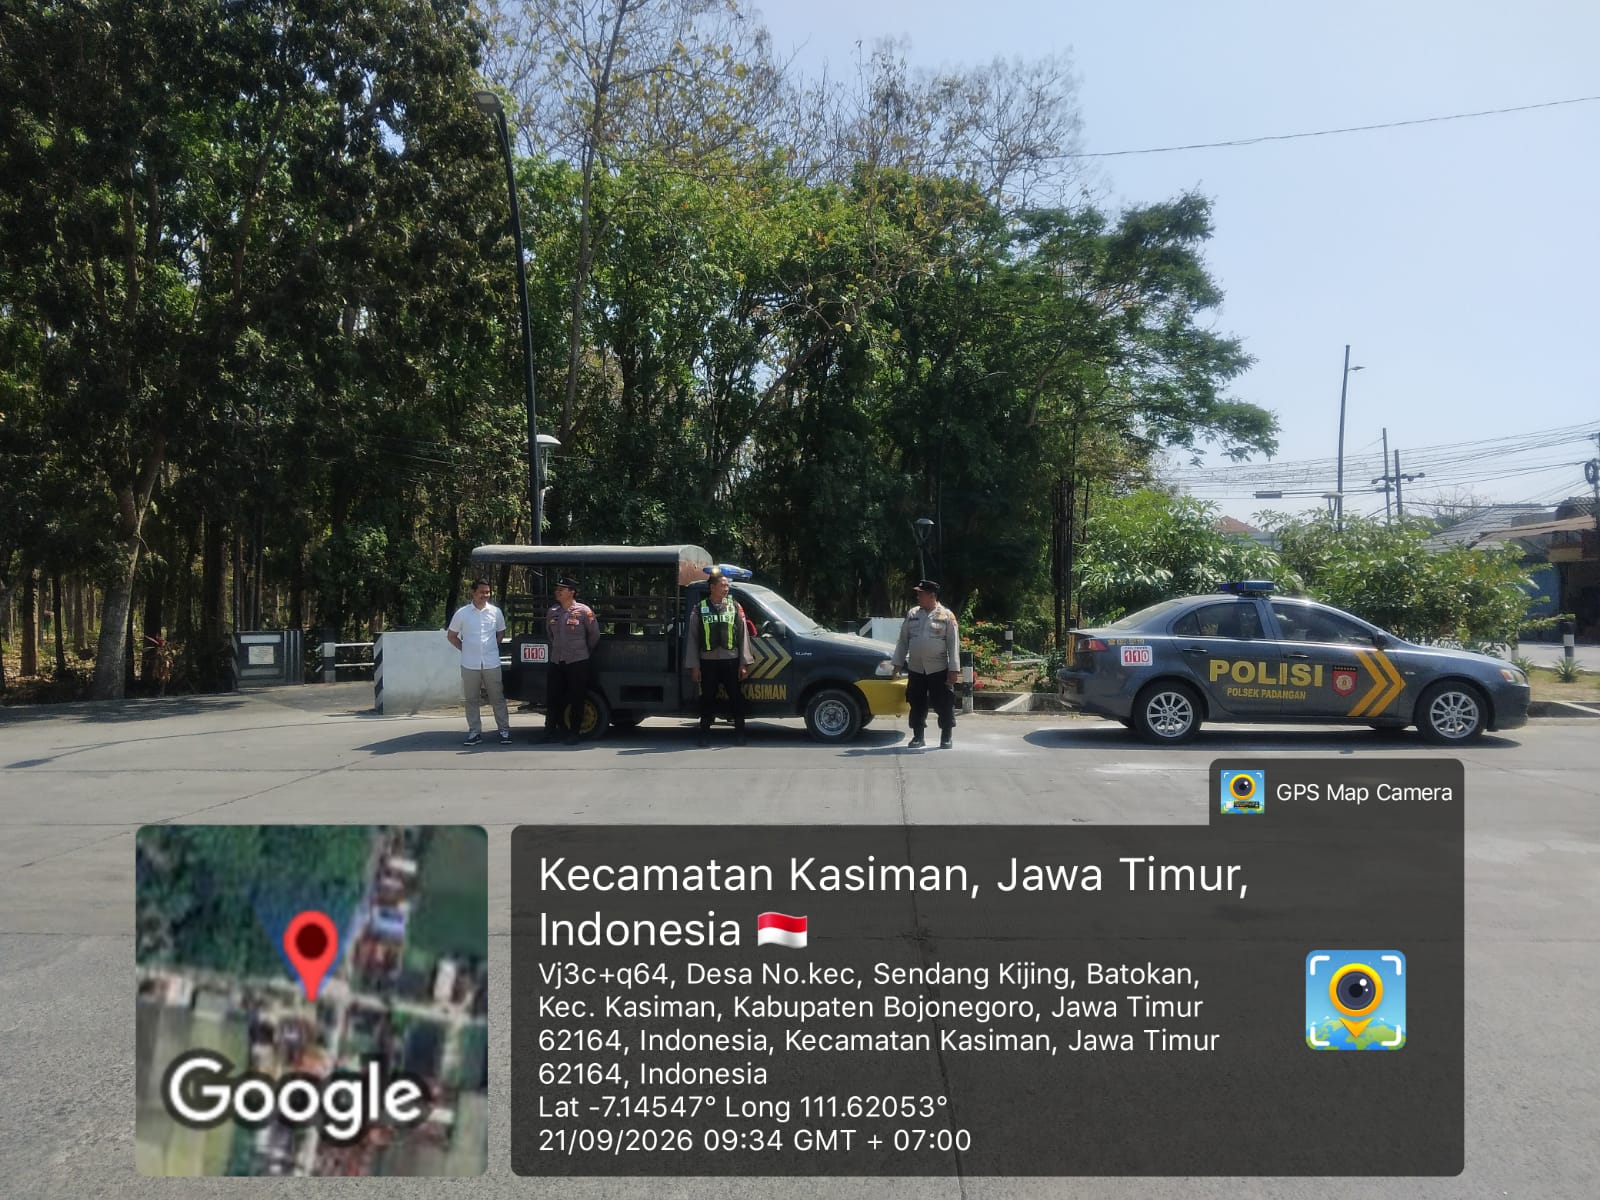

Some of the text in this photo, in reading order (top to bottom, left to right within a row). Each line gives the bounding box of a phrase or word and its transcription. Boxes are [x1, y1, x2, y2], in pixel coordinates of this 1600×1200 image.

[523, 647, 546, 660] 110
[1124, 650, 1150, 663] 110
[1209, 659, 1323, 688] POLISI
[1226, 687, 1306, 701] POLSEK PADANGAN
